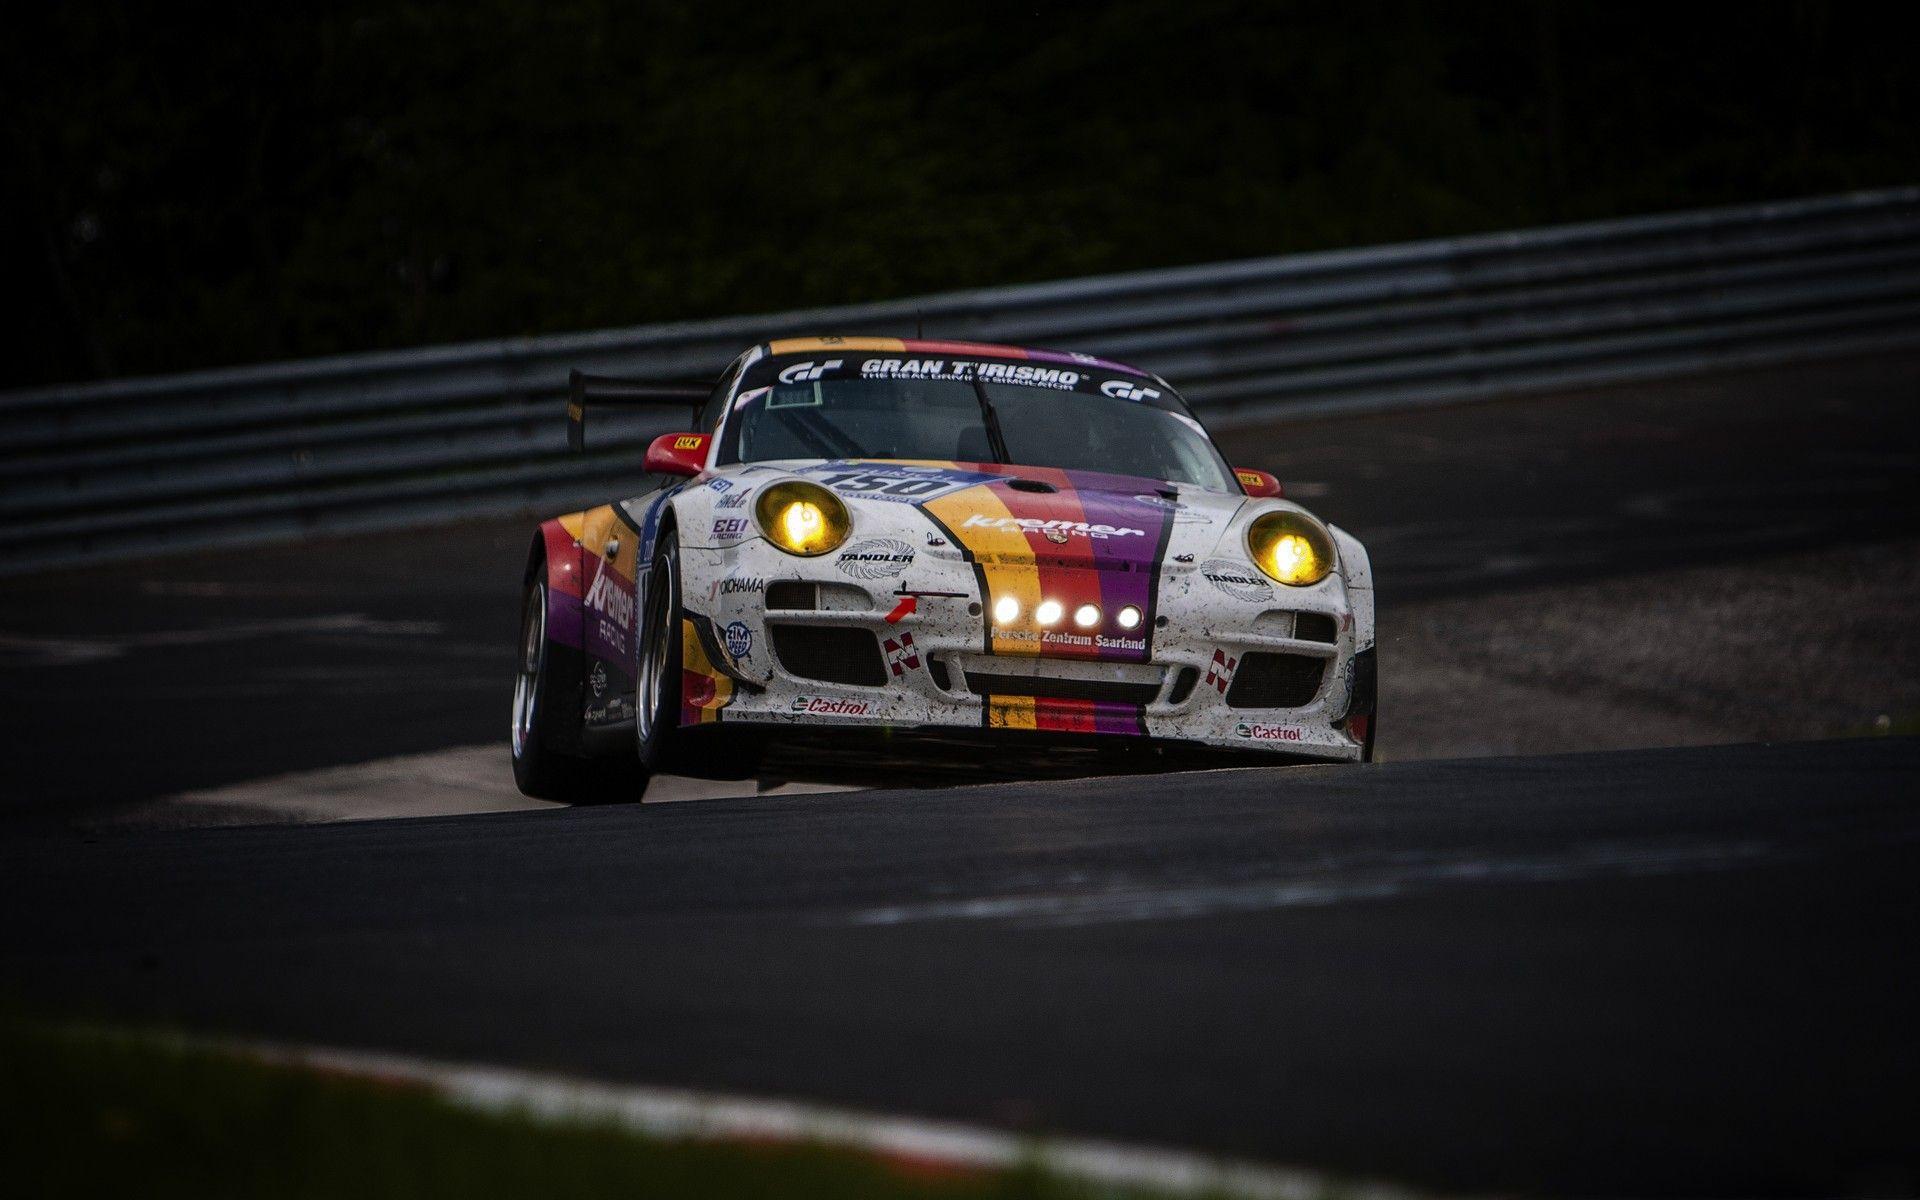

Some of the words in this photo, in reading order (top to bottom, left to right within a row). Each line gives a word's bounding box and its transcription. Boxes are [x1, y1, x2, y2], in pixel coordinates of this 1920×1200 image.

[861, 358, 945, 374] GRAN
[861, 372, 886, 380] THE
[820, 474, 951, 496] 150
[841, 552, 915, 564] TANDLER
[1204, 573, 1269, 587] TANDLER
[1041, 630, 1092, 646] Zentrum
[1095, 634, 1146, 650] Saarland
[809, 698, 869, 715] Castrol
[1252, 724, 1300, 741] Castrol
